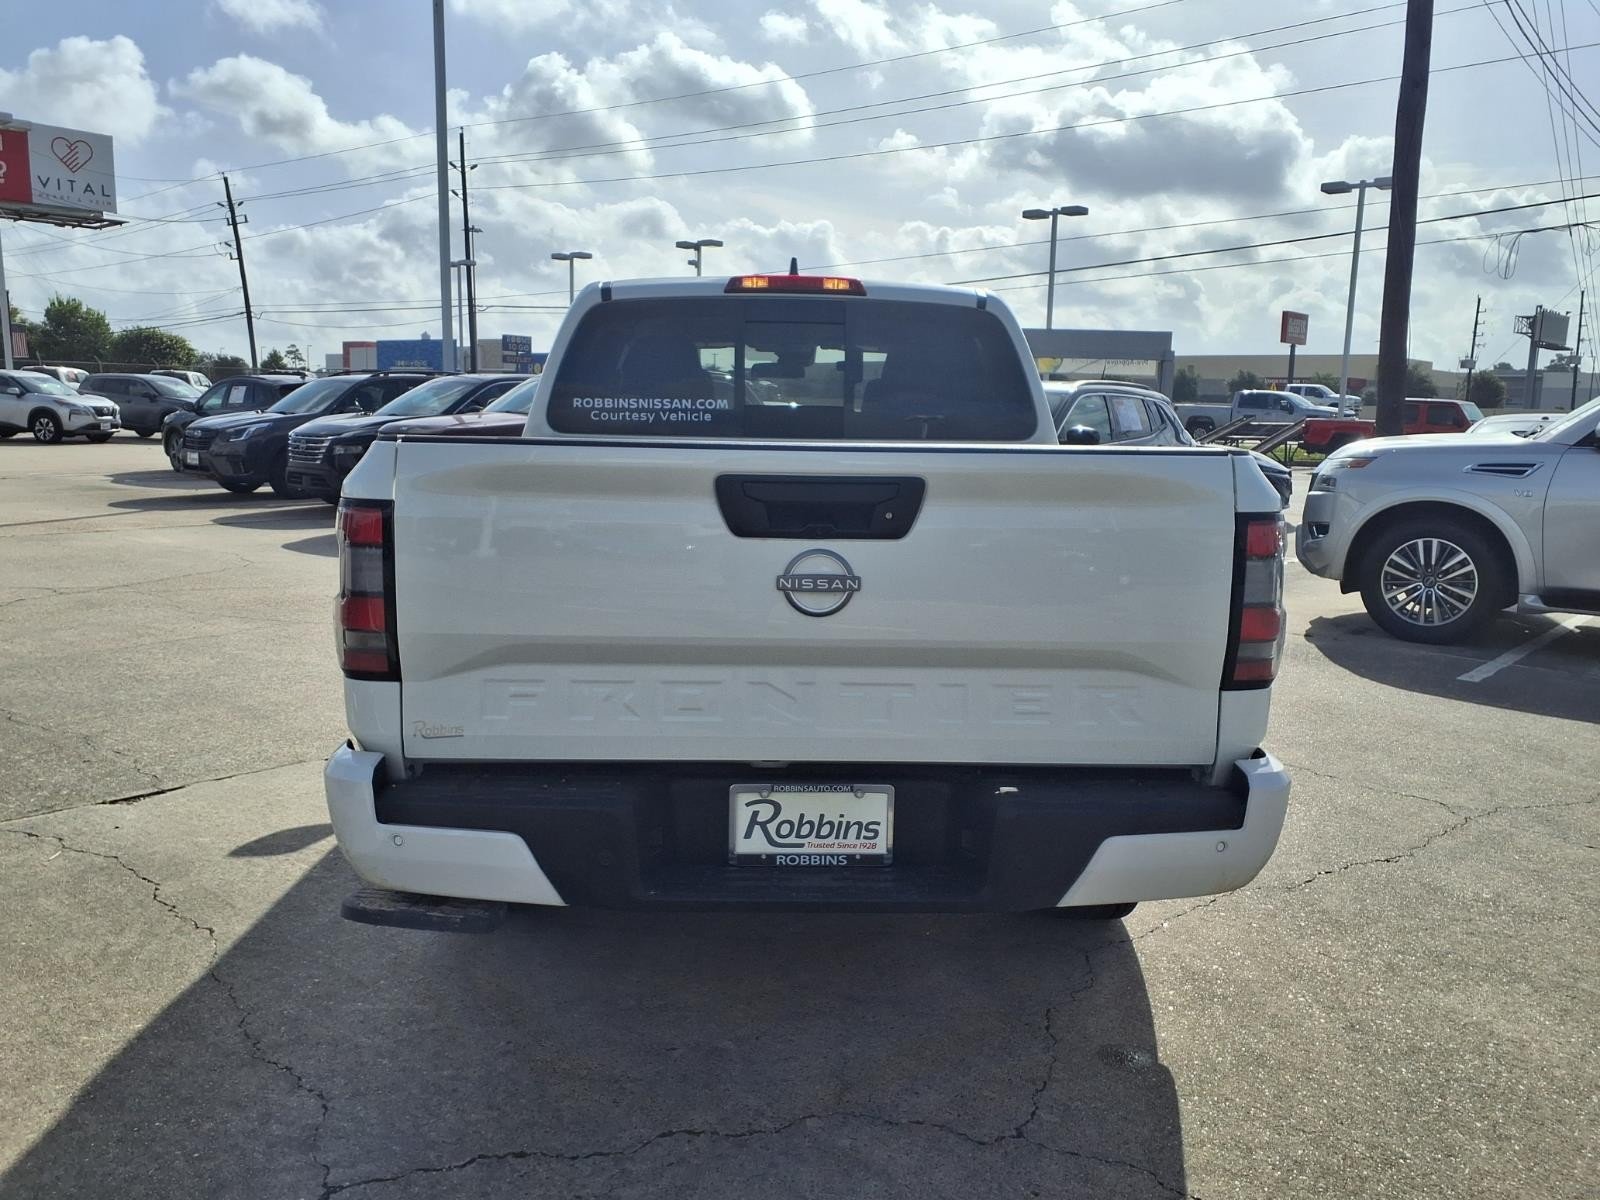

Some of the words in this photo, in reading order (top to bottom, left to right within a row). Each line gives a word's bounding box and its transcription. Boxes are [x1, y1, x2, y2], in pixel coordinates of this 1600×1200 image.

[37, 175, 111, 198] VITAL
[572, 397, 729, 410] ROBBINSNISSAN.COM
[590, 410, 655, 423] Courtesy
[660, 411, 712, 422] Vehicle
[779, 578, 858, 589] NISSAN
[482, 679, 1144, 725] FRONTIER
[412, 719, 465, 739] Robbins
[773, 784, 851, 793] ROBBINSAUTO.COM
[743, 798, 882, 848] Robbins
[807, 841, 836, 849] Trusted
[836, 842, 857, 850] Since
[858, 842, 878, 850] 1928
[776, 854, 848, 866] ROBBINS
